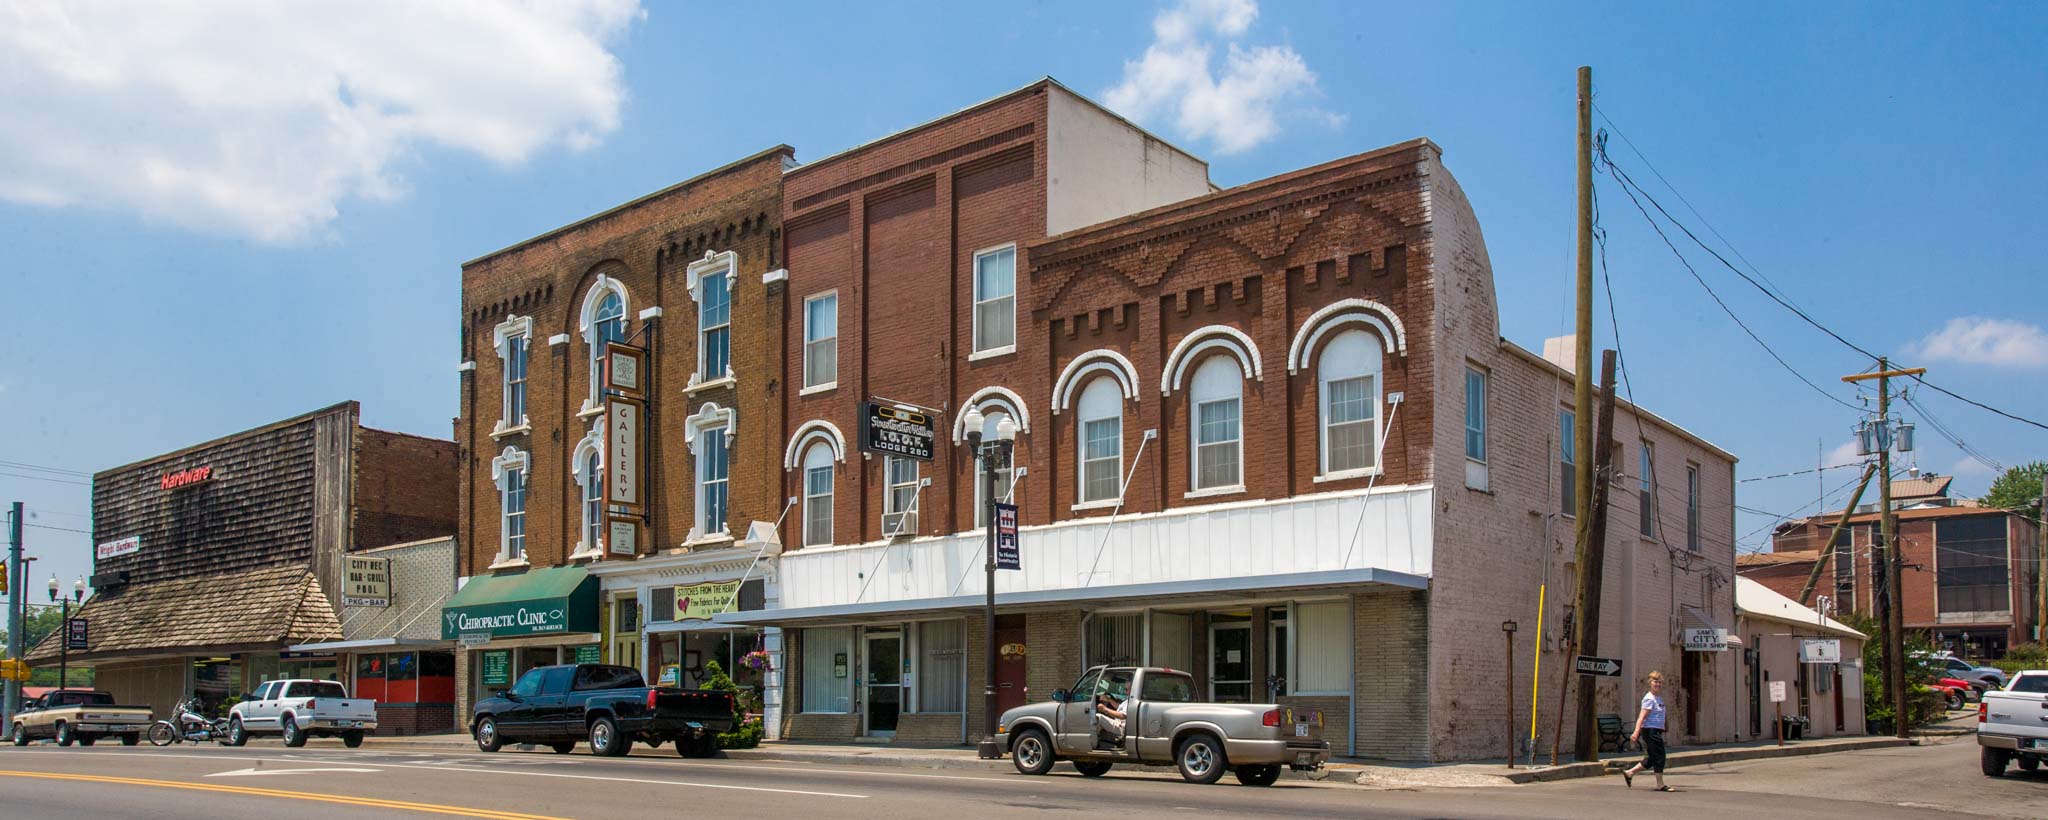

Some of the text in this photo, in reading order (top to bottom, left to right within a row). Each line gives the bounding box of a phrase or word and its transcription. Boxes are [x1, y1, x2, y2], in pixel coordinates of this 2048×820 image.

[875, 441, 907, 452] LODGE
[619, 408, 628, 497] GALLERY
[161, 465, 210, 490] Hardware
[352, 560, 382, 570] CITY REC
[356, 584, 378, 594] POOL
[678, 584, 736, 597] STITCHES FROM THE HEART
[1580, 661, 1592, 669] ONE
